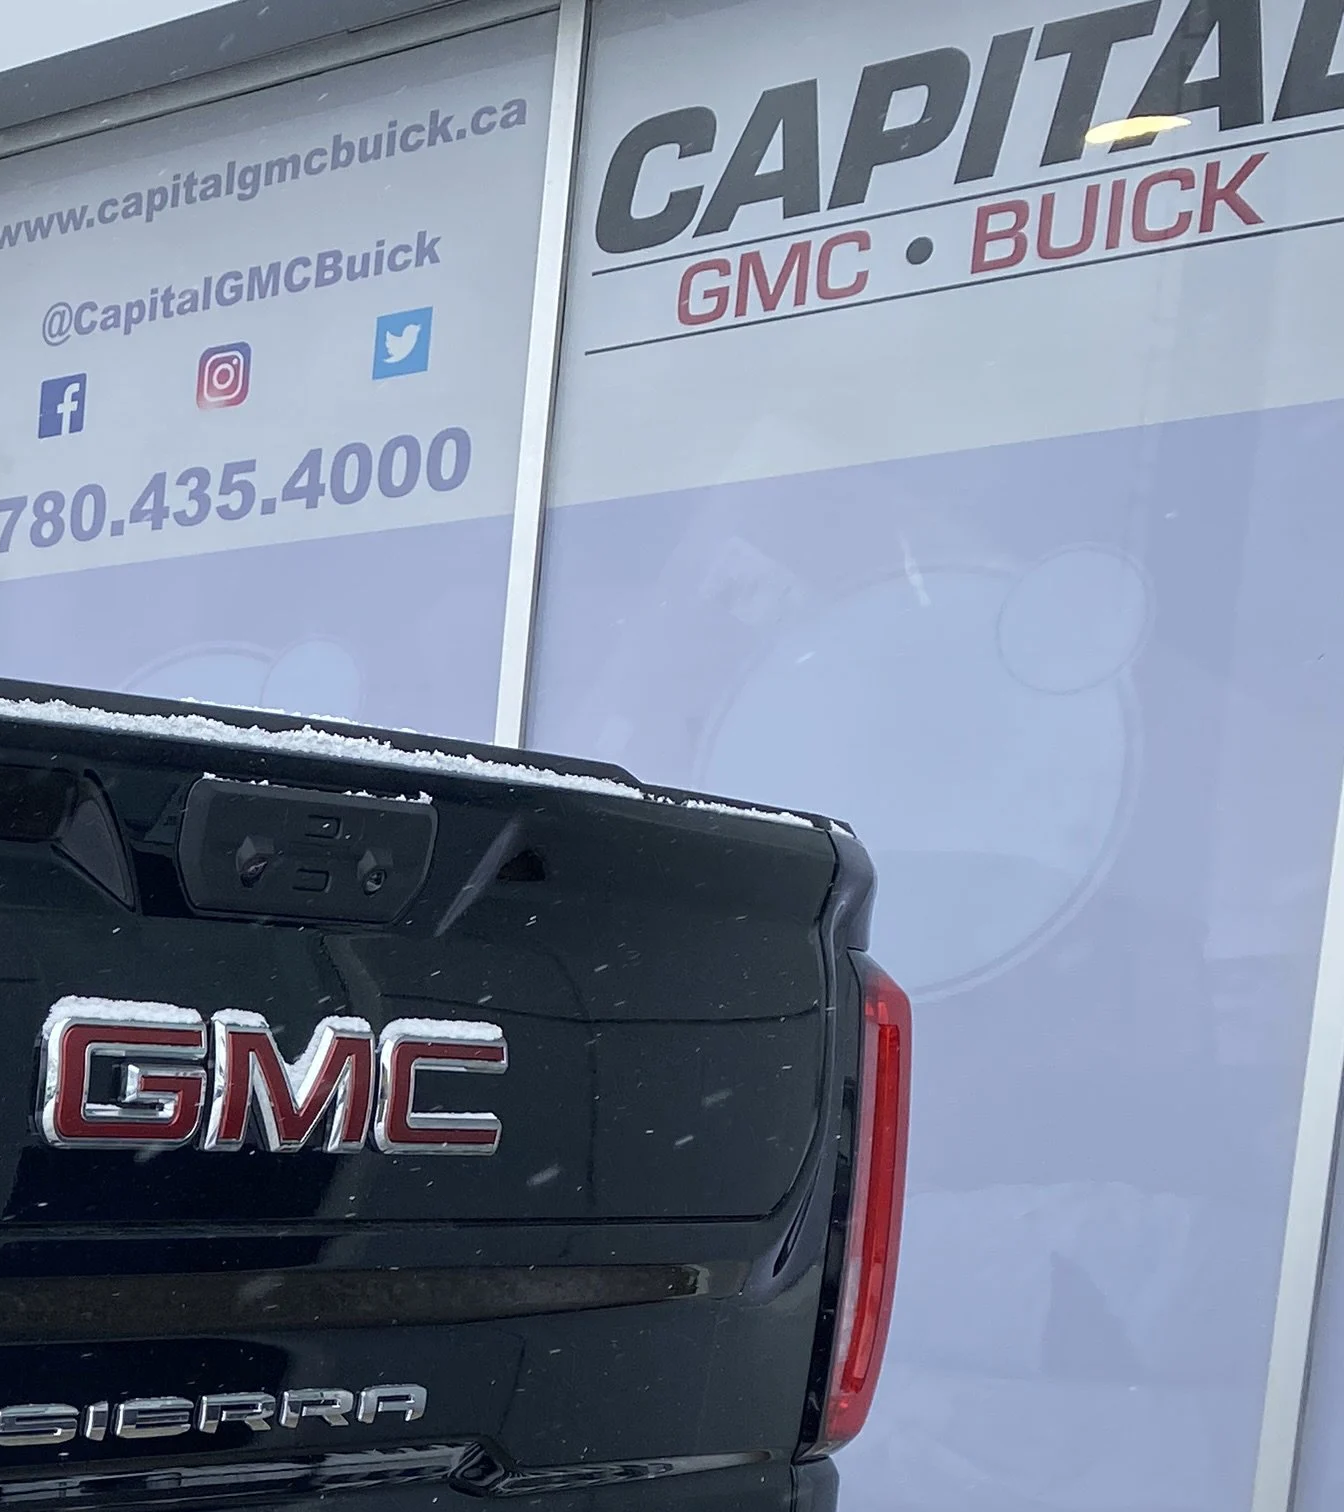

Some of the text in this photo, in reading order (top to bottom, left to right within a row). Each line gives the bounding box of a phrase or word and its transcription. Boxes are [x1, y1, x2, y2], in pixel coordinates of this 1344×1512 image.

[595, 0, 1344, 254] CAPITAL
[41, 230, 442, 347] @CapitalGMCBuick
[677, 151, 1270, 327] GMC BUICK
[39, 1006, 509, 1156] GMC
